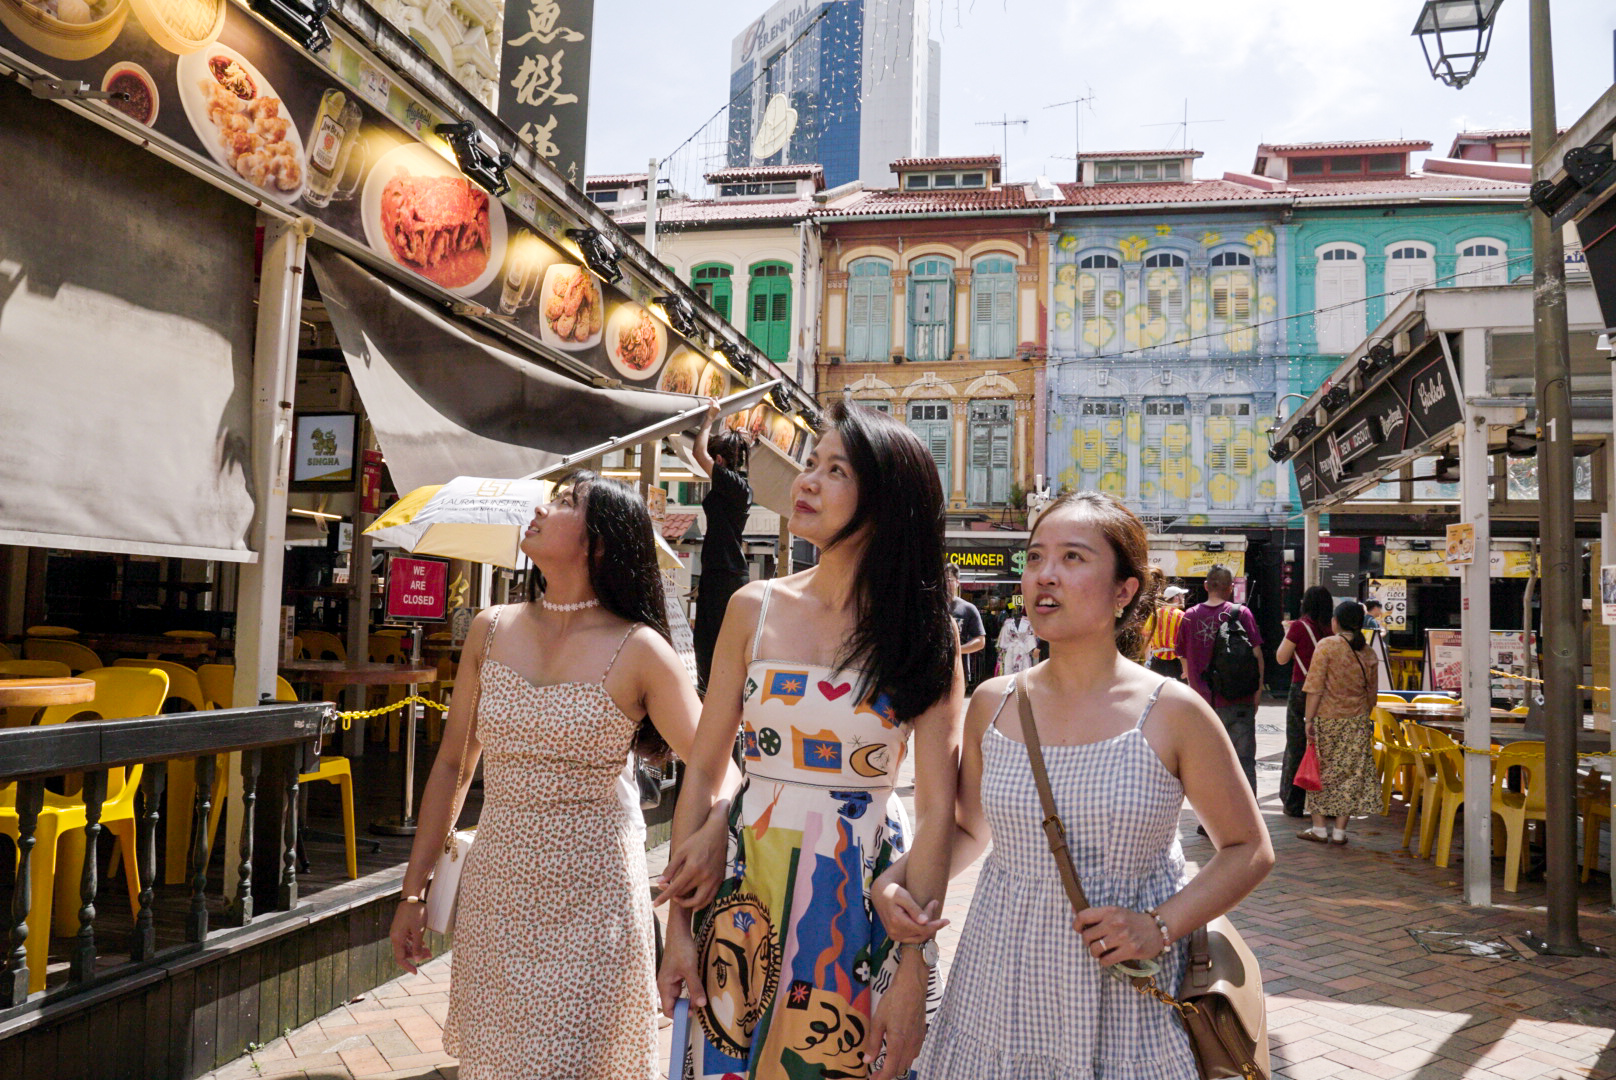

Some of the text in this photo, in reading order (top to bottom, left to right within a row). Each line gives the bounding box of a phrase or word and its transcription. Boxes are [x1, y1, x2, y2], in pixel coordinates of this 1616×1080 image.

[741, 0, 811, 63] PERENNIAL
[1546, 418, 1557, 442] 1
[307, 458, 340, 466] SINGHA
[441, 498, 531, 508] LAURA SUNSHINE
[950, 552, 1005, 567] CHANGER
[413, 565, 426, 576] WE
[410, 580, 426, 591] ARE
[403, 594, 435, 606] CLOSED
